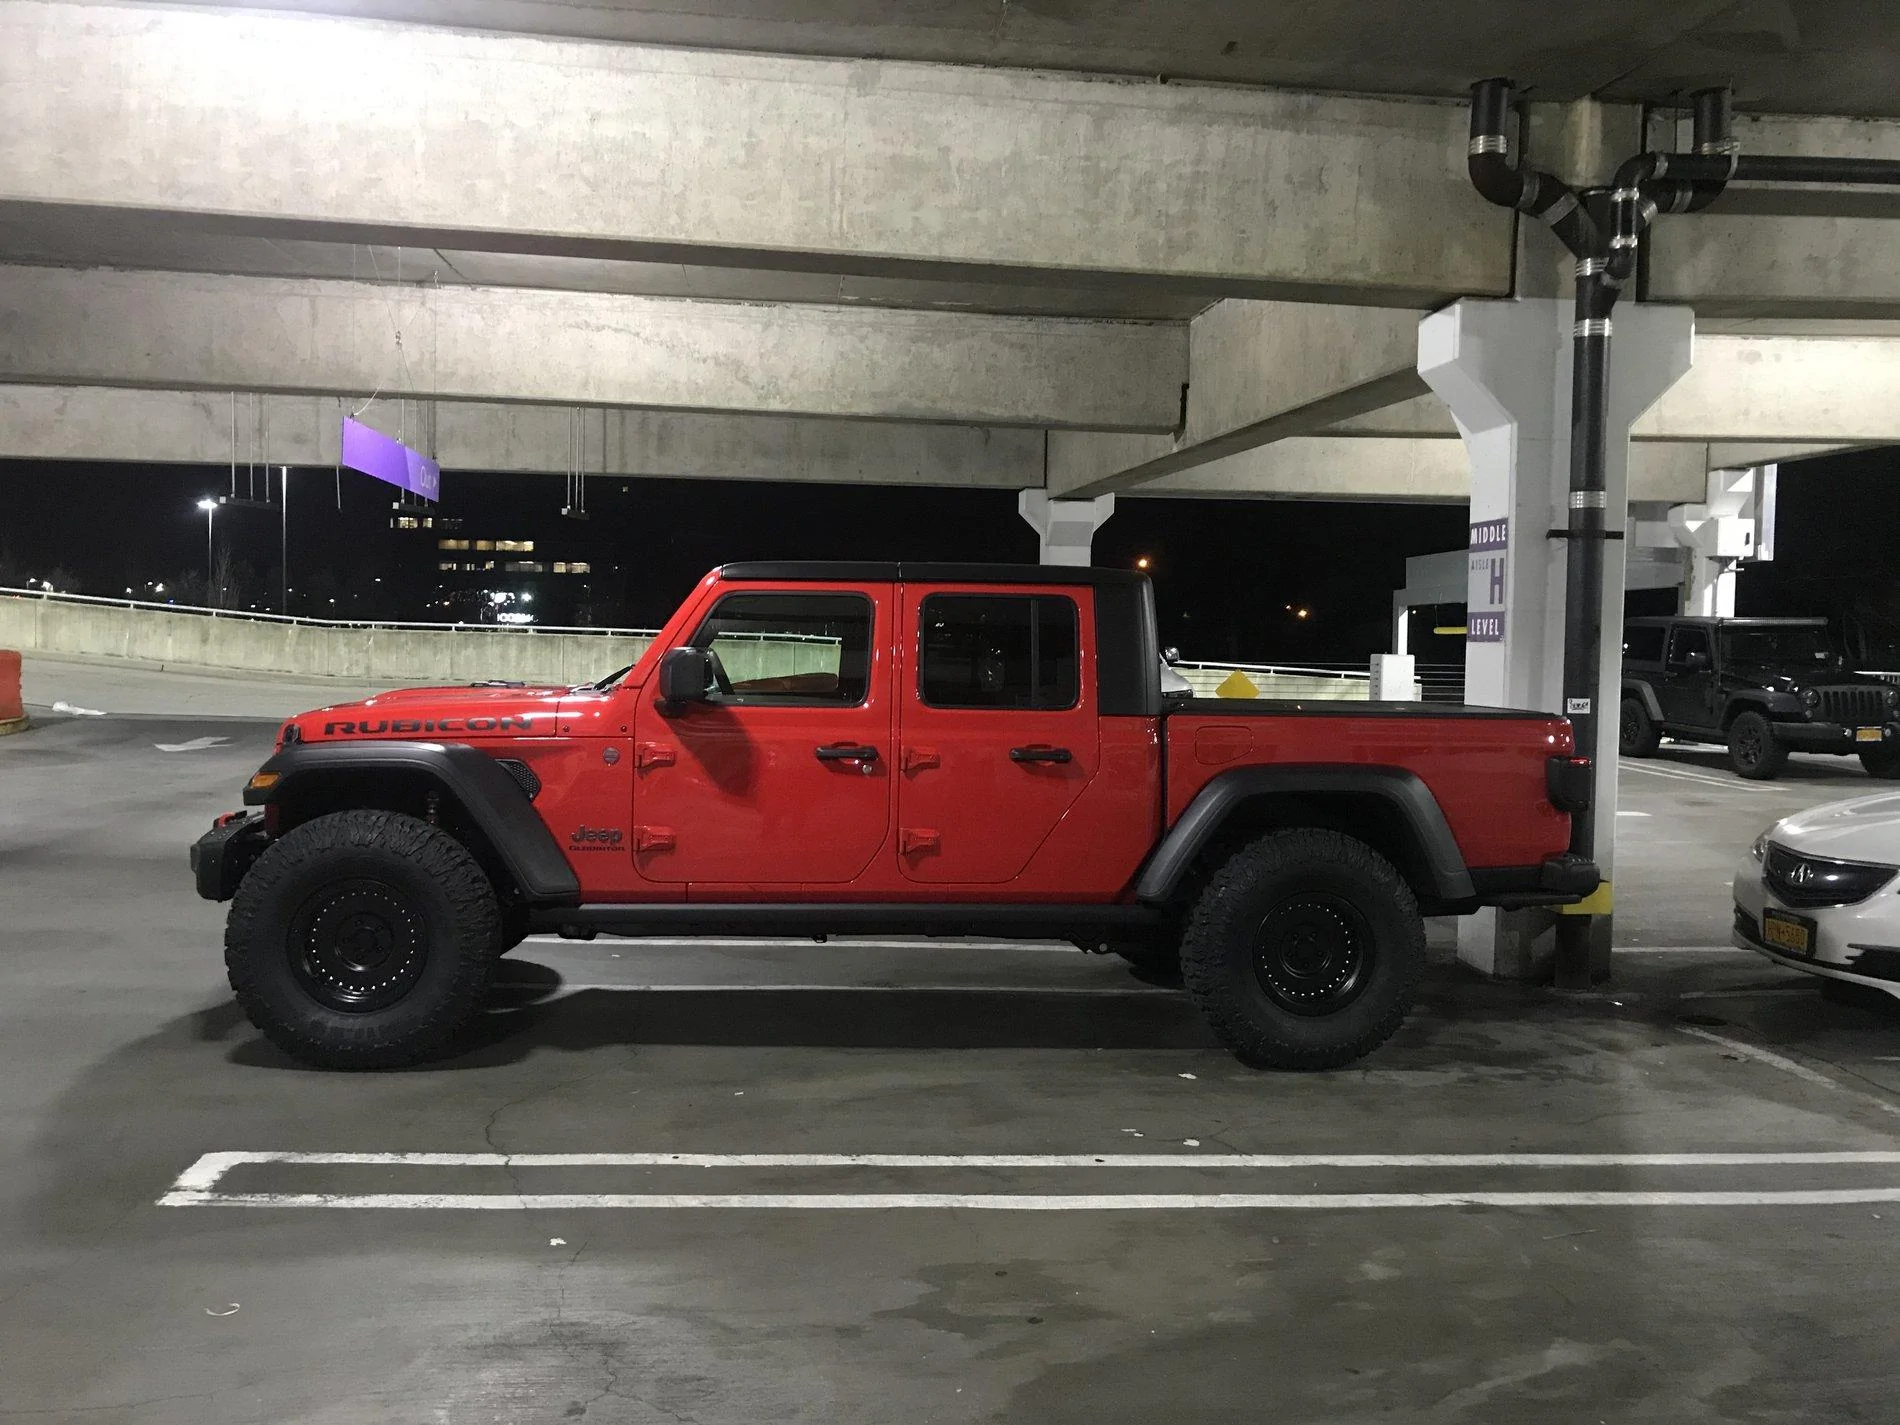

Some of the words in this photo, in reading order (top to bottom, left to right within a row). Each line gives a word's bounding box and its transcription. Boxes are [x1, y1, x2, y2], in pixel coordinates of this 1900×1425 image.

[1470, 523, 1506, 545] MIDDLE
[1489, 557, 1505, 605] H
[1471, 618, 1499, 636] LEVEL
[324, 716, 533, 736] RUBICON
[571, 824, 623, 843] Jeep
